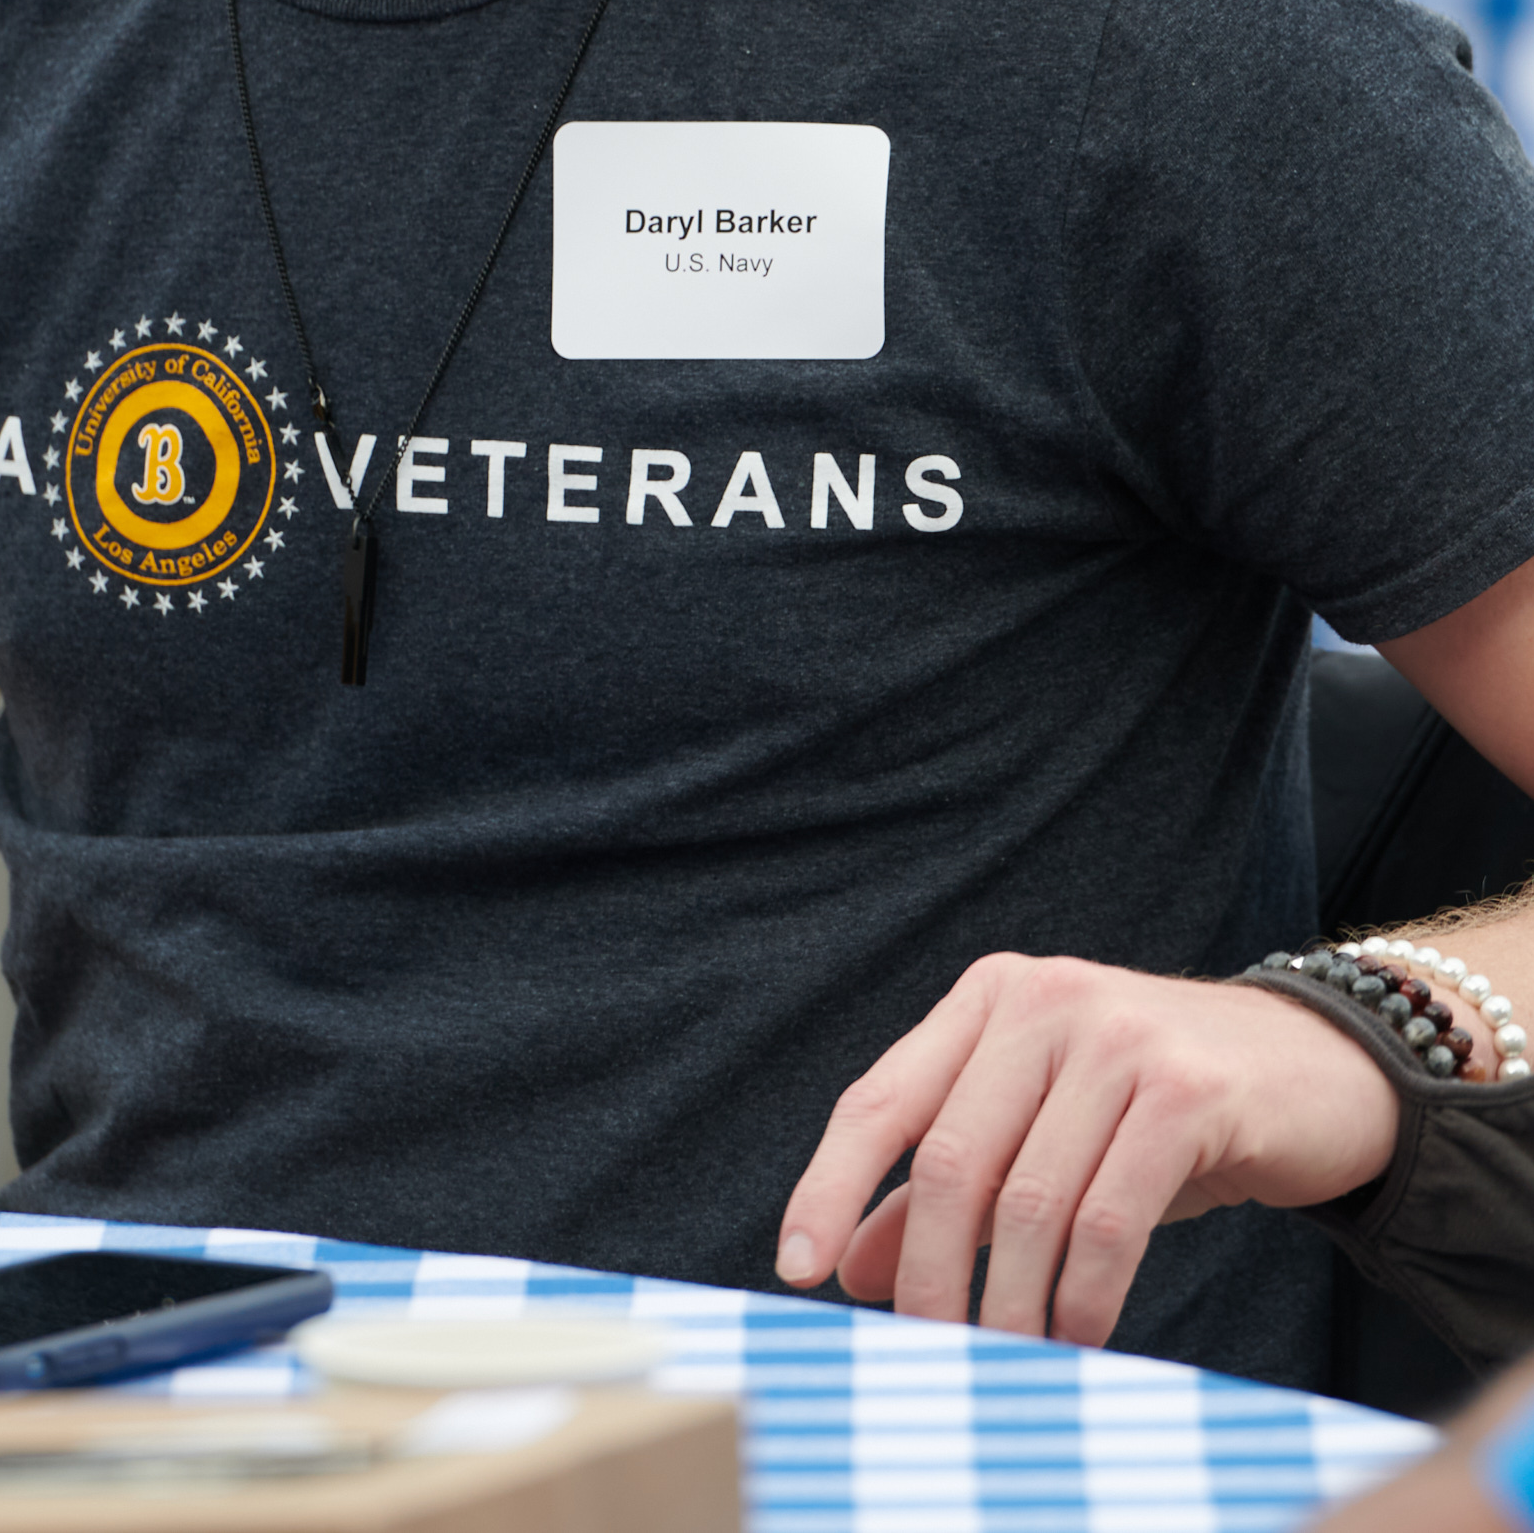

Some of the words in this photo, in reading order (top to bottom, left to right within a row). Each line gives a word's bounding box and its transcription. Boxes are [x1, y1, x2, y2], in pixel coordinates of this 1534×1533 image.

[625, 209, 703, 241] Daryl
[716, 209, 818, 234] Barker
[665, 253, 709, 273] U.S.
[719, 253, 773, 277] Navy
[74, 359, 157, 457] University
[164, 354, 189, 374] of
[191, 359, 261, 465] California
[131, 423, 185, 505] B
[314, 431, 965, 533] VETERANS
[93, 522, 135, 565] Los
[138, 529, 238, 577] Angeles
